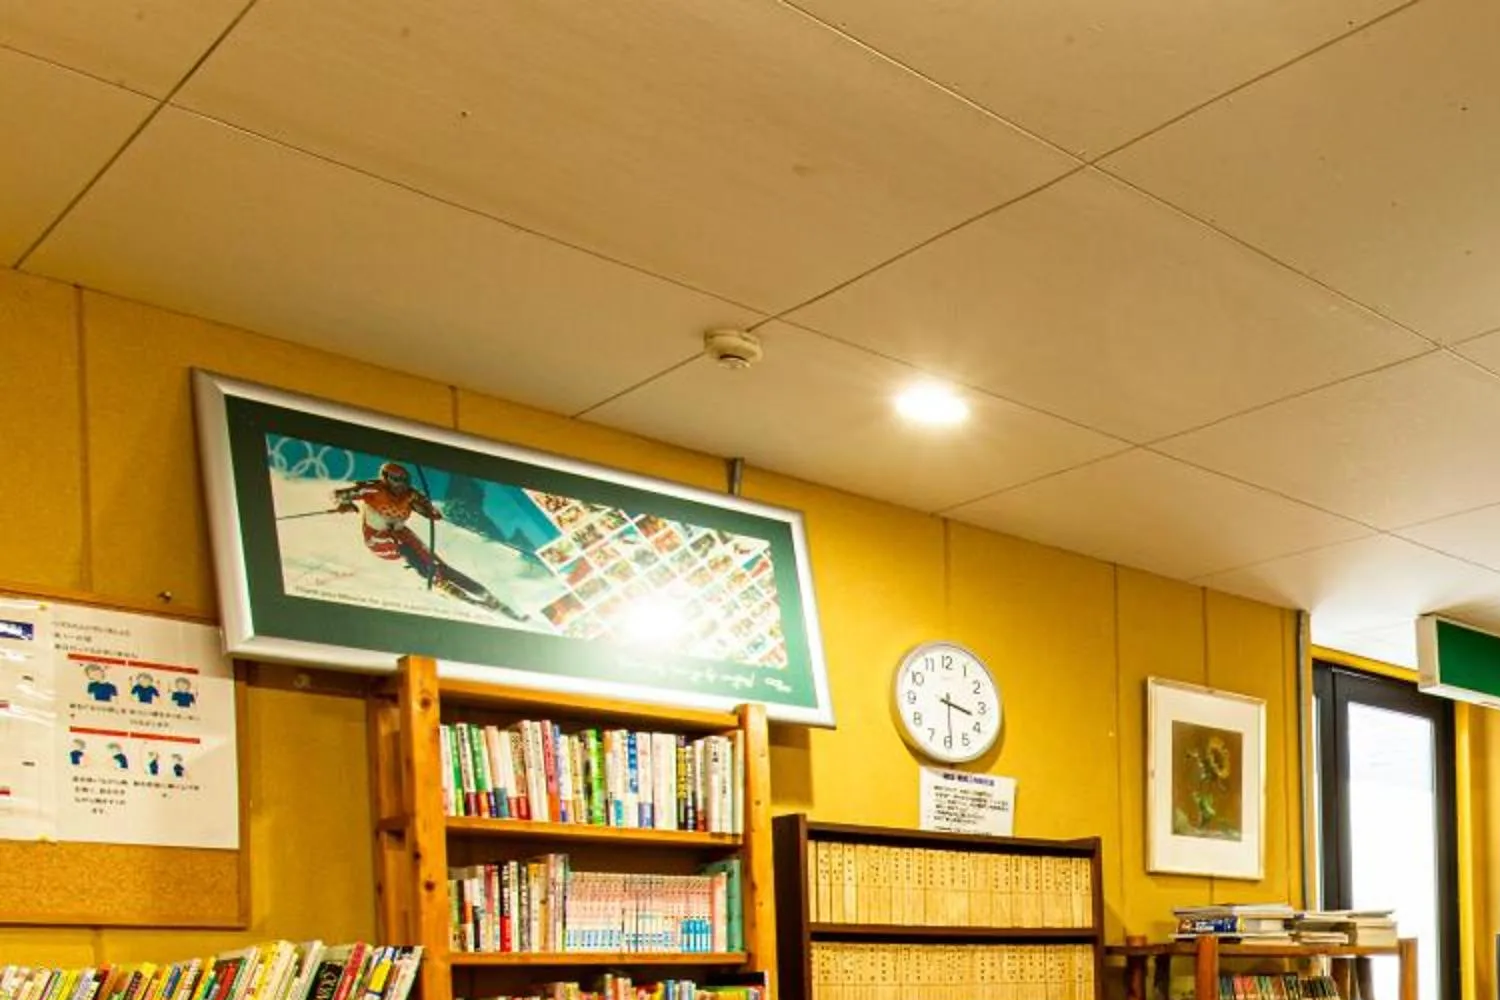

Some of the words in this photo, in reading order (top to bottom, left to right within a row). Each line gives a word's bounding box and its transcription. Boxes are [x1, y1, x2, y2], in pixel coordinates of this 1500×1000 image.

[924, 657, 935, 672] 11
[941, 655, 953, 670] 12
[911, 671, 925, 686] 10
[963, 665, 967, 677] 1
[972, 679, 981, 694] 2
[907, 689, 917, 705] 9
[977, 701, 987, 715] 3
[913, 711, 922, 727] 8
[927, 727, 935, 742] 7
[972, 721, 981, 733] 4
[943, 735, 953, 749] 6
[961, 732, 971, 747] 5
